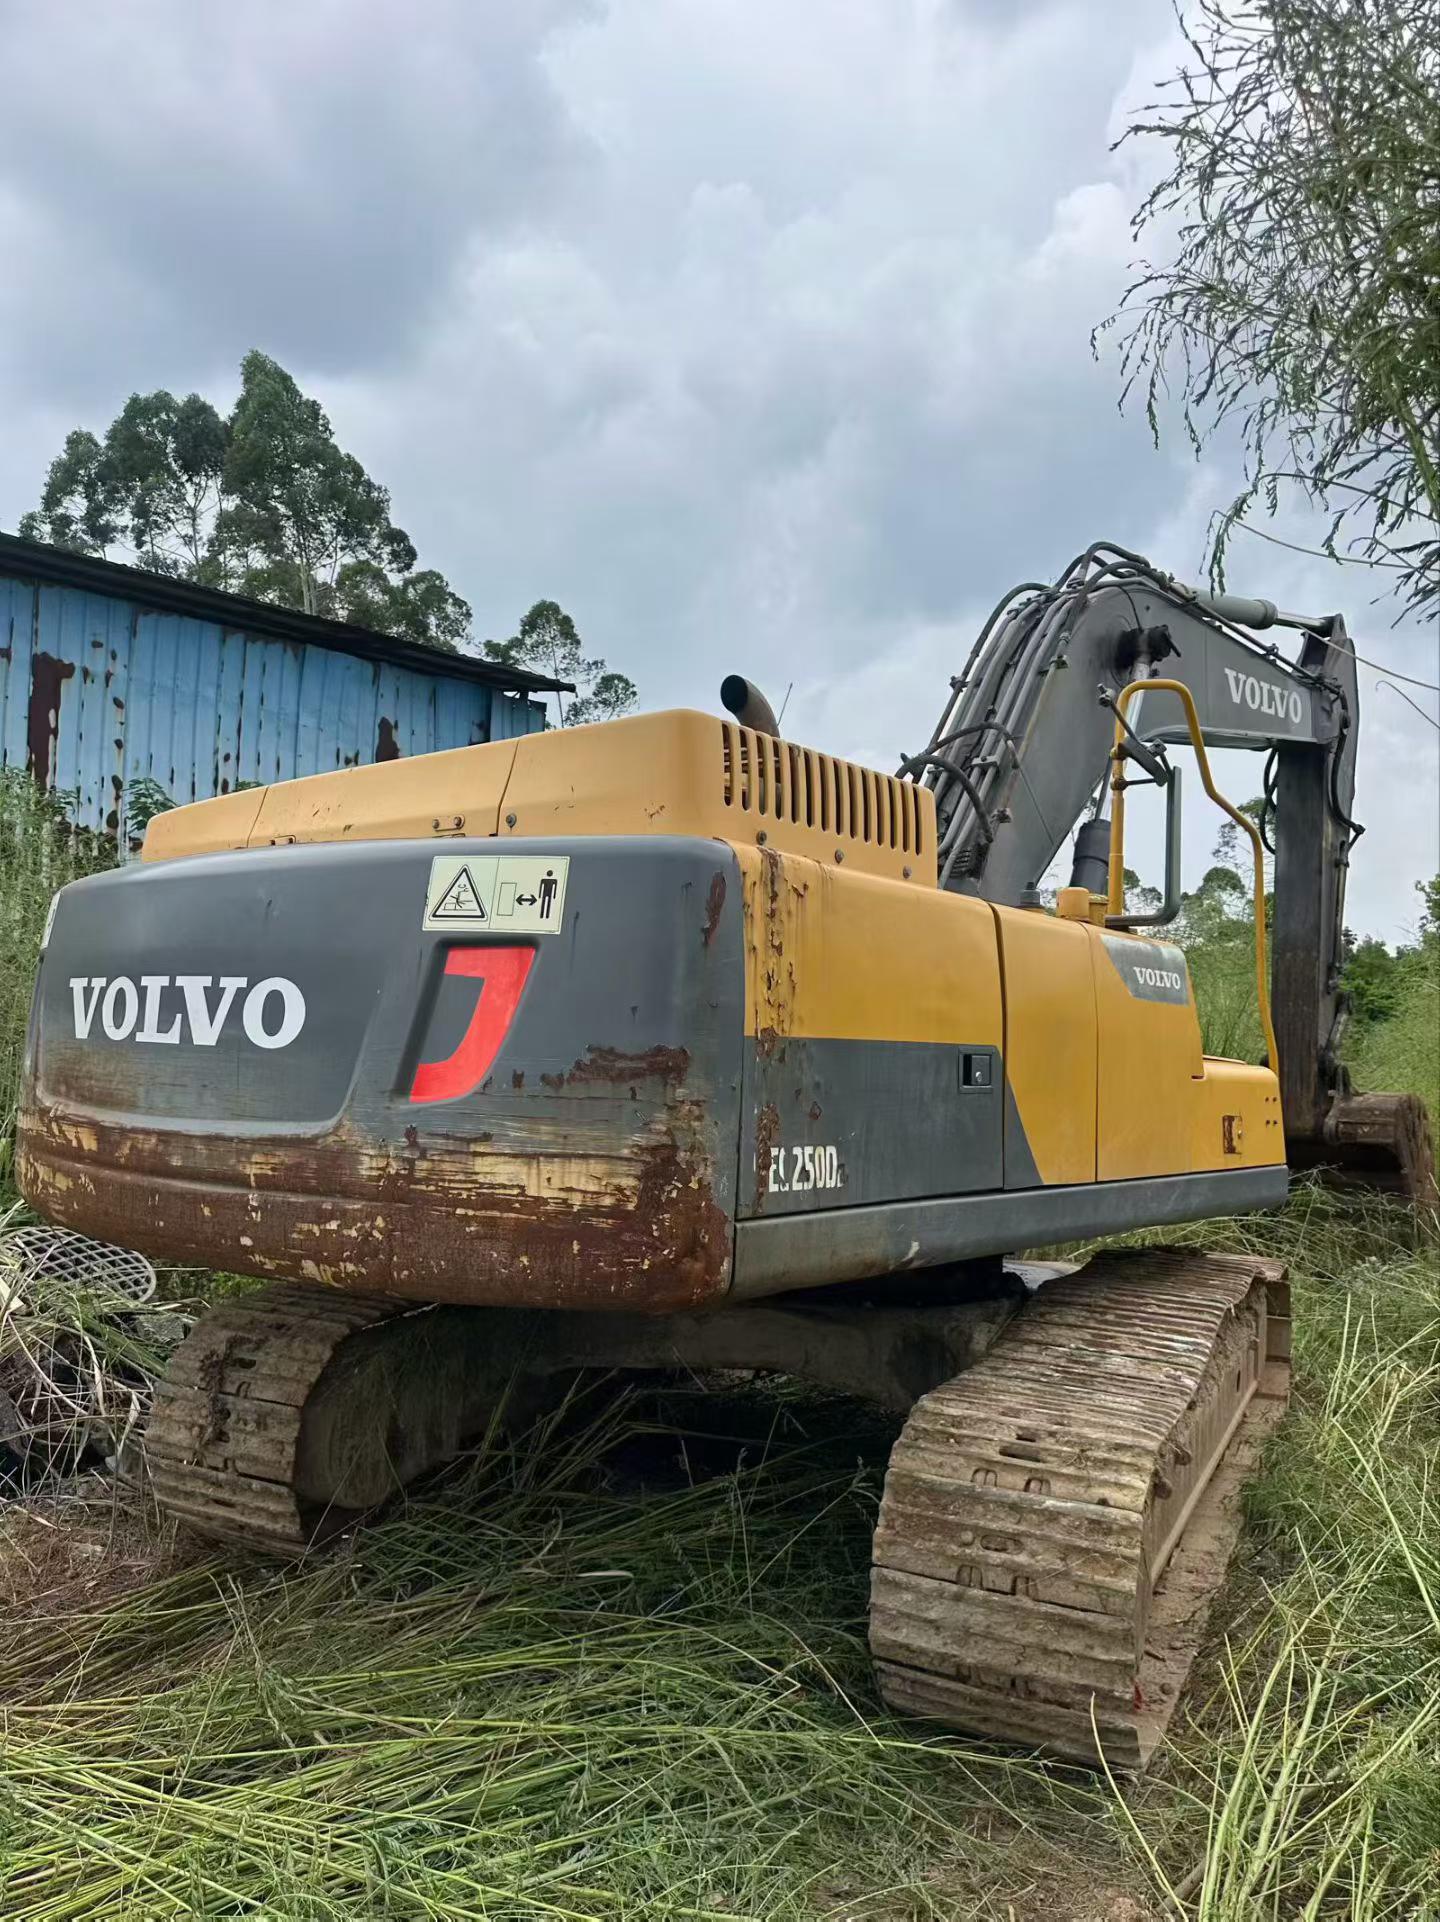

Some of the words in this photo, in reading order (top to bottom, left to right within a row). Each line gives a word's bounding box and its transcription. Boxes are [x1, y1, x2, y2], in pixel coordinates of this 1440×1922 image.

[1224, 667, 1303, 724] VOLVO
[1133, 966, 1181, 990] VOLVO
[69, 975, 306, 1049] VOLVO
